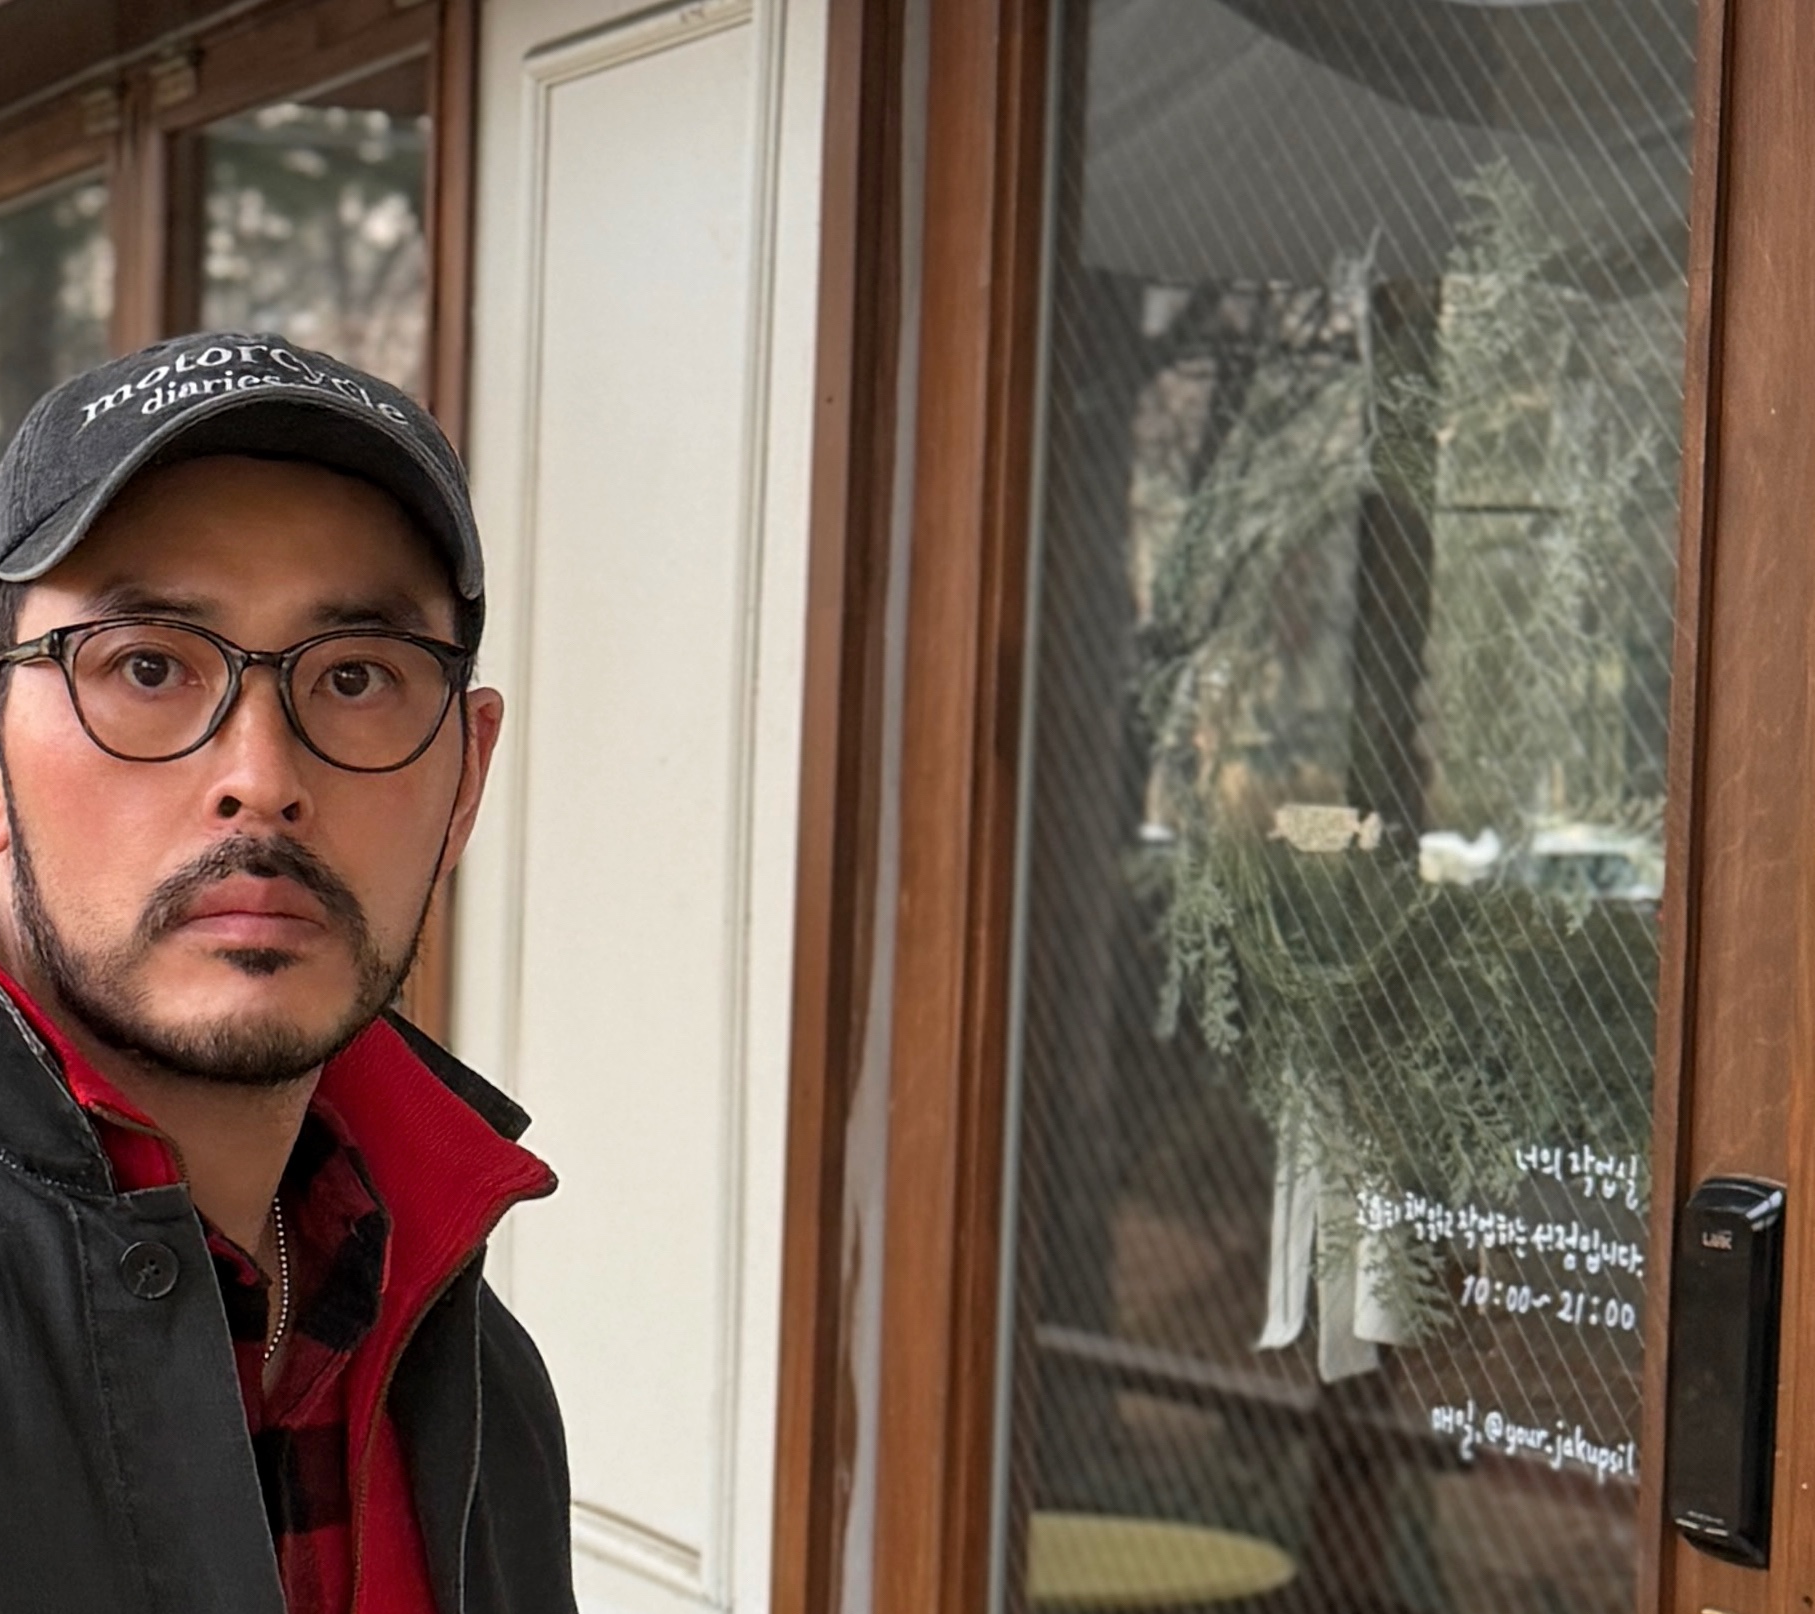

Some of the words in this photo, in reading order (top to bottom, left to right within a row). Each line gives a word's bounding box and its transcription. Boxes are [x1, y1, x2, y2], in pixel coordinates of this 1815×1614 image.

[81, 344, 409, 427] motorcycle
[141, 370, 282, 415] diaries
[1515, 1144, 1562, 1182] 너의
[1567, 1144, 1640, 1211] 작업실
